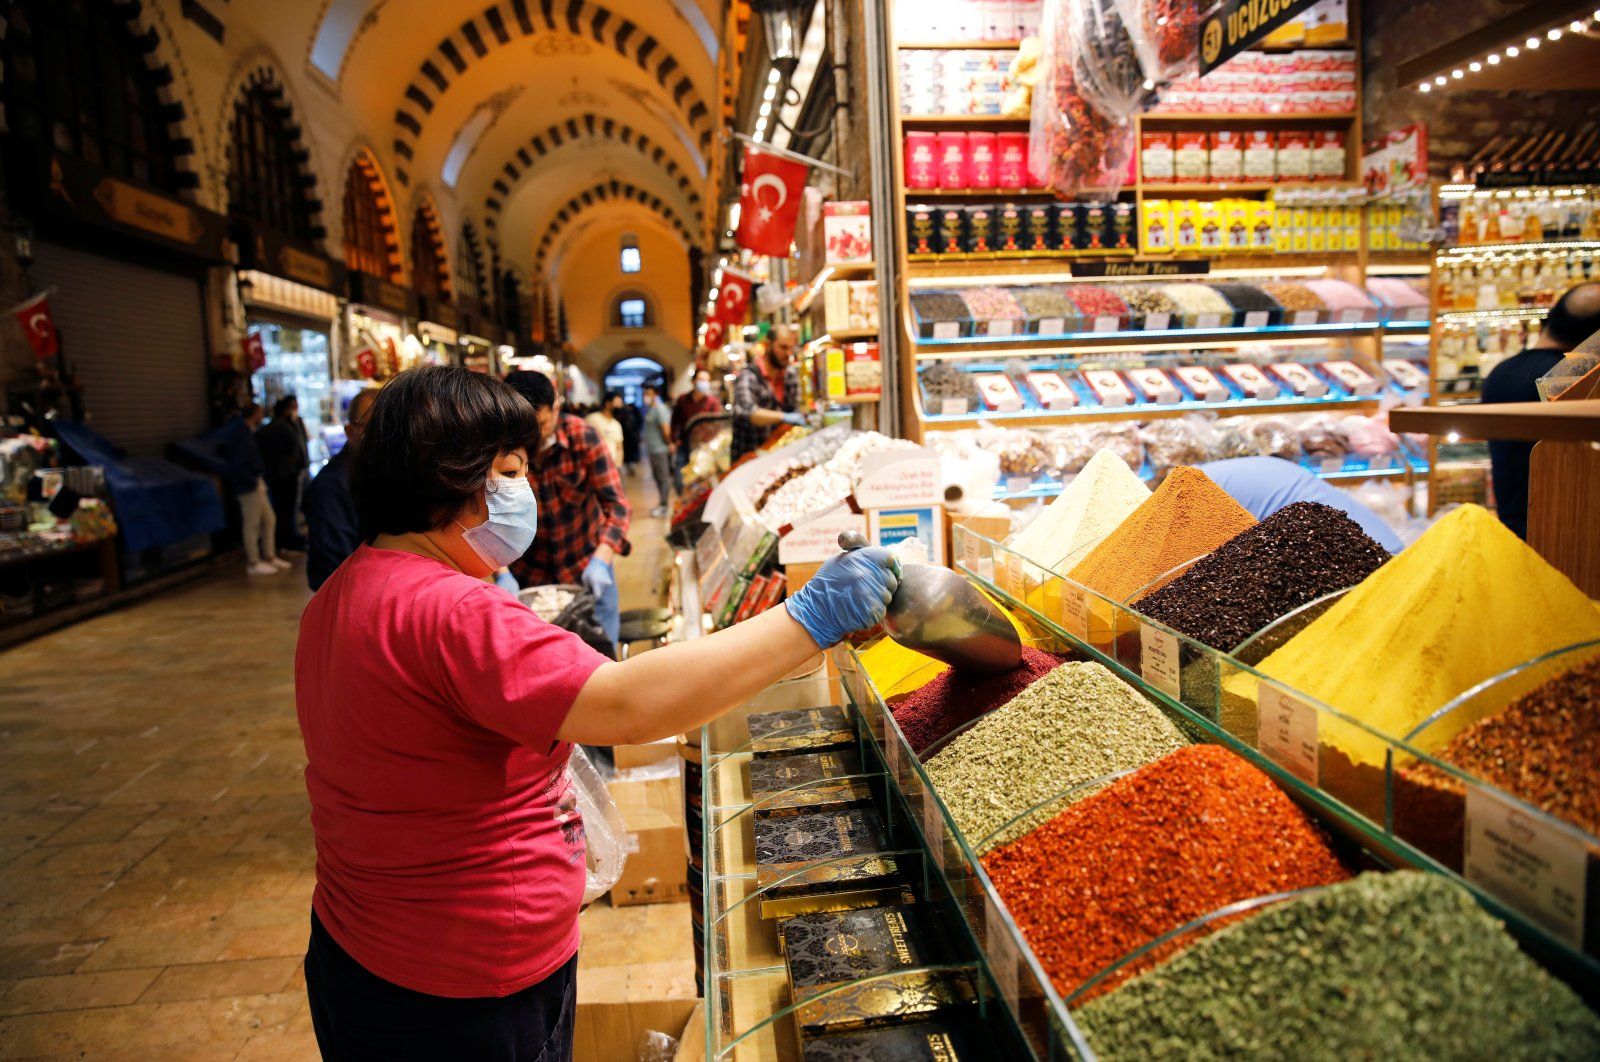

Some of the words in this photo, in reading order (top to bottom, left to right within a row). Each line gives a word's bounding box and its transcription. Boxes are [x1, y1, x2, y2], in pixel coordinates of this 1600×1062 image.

[1228, 0, 1297, 46] UCUZC
[1105, 262, 1149, 276] Herbal
[884, 911, 902, 937] TREATS
[894, 937, 912, 964] SWEET
